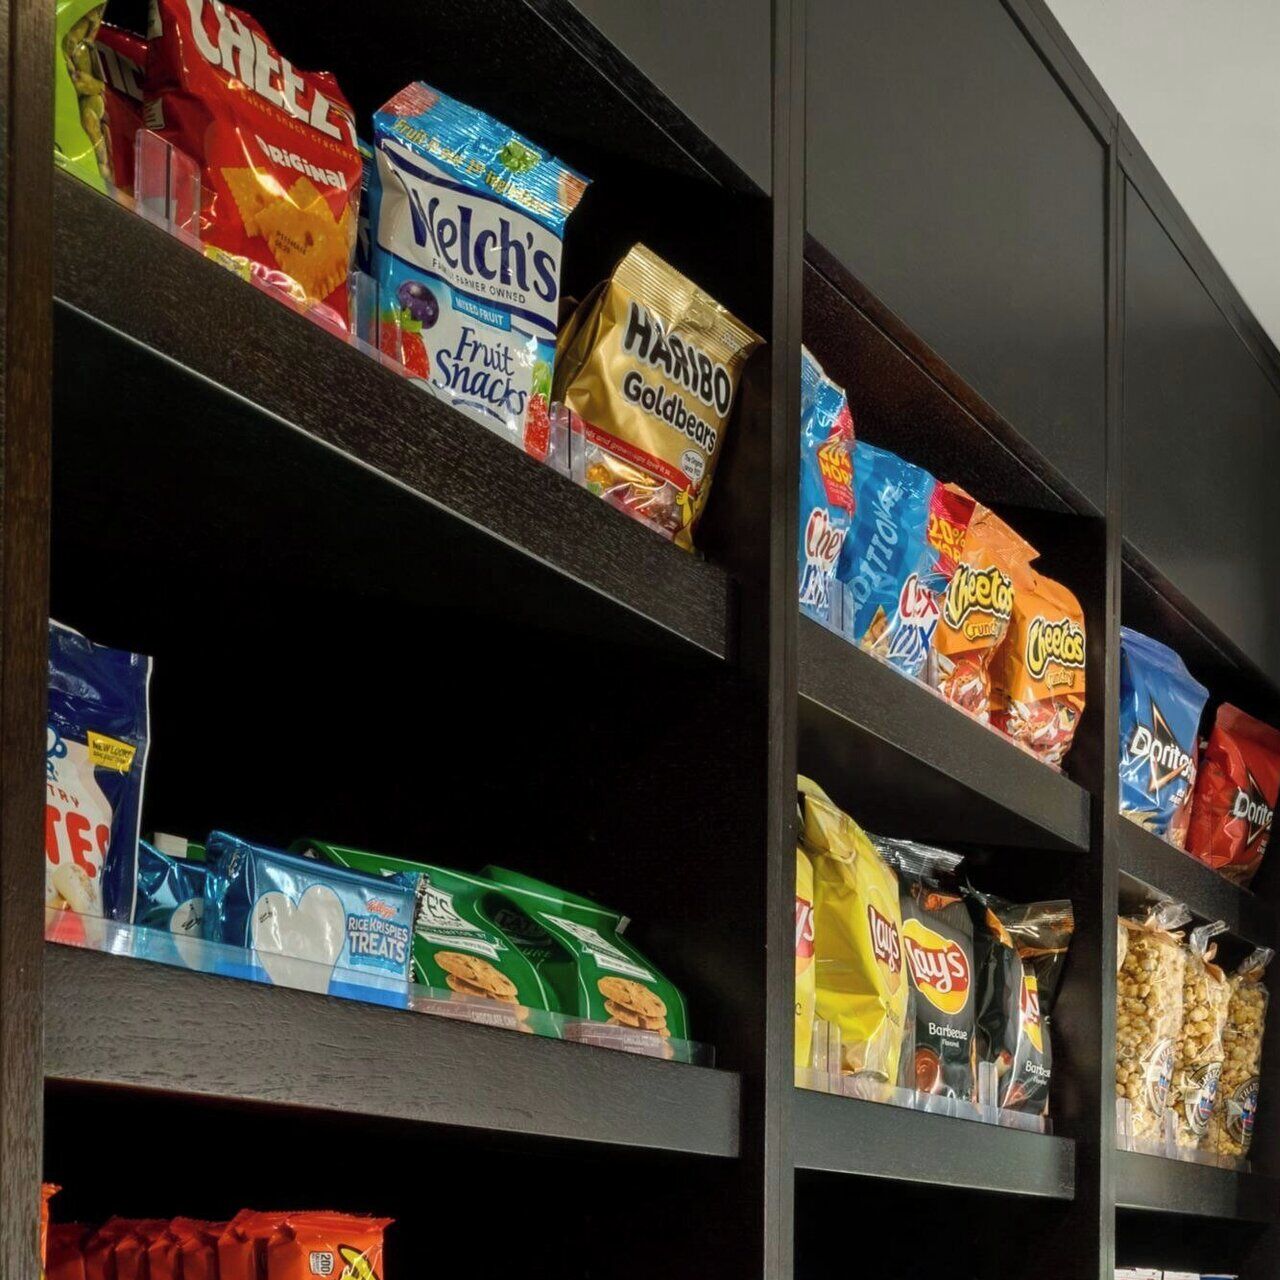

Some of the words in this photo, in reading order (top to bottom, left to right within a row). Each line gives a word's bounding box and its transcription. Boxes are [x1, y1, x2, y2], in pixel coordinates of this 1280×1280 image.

[397, 188, 558, 303] Welch's
[480, 304, 504, 326] FRUIT
[488, 285, 526, 304] OWNED
[453, 326, 515, 376] Fruit
[623, 301, 732, 416] HARIBO
[432, 348, 528, 416] Snacks
[623, 370, 717, 454] Goldbears
[1028, 617, 1085, 677] Cheetos
[348, 917, 369, 932] RICE
[369, 919, 408, 943] KRISPIES
[350, 932, 406, 963] TREATS
[869, 907, 899, 972] Lay's
[904, 939, 966, 994] Lay's
[928, 1022, 968, 1041] Barbecue
[320, 1253, 333, 1274] 200
